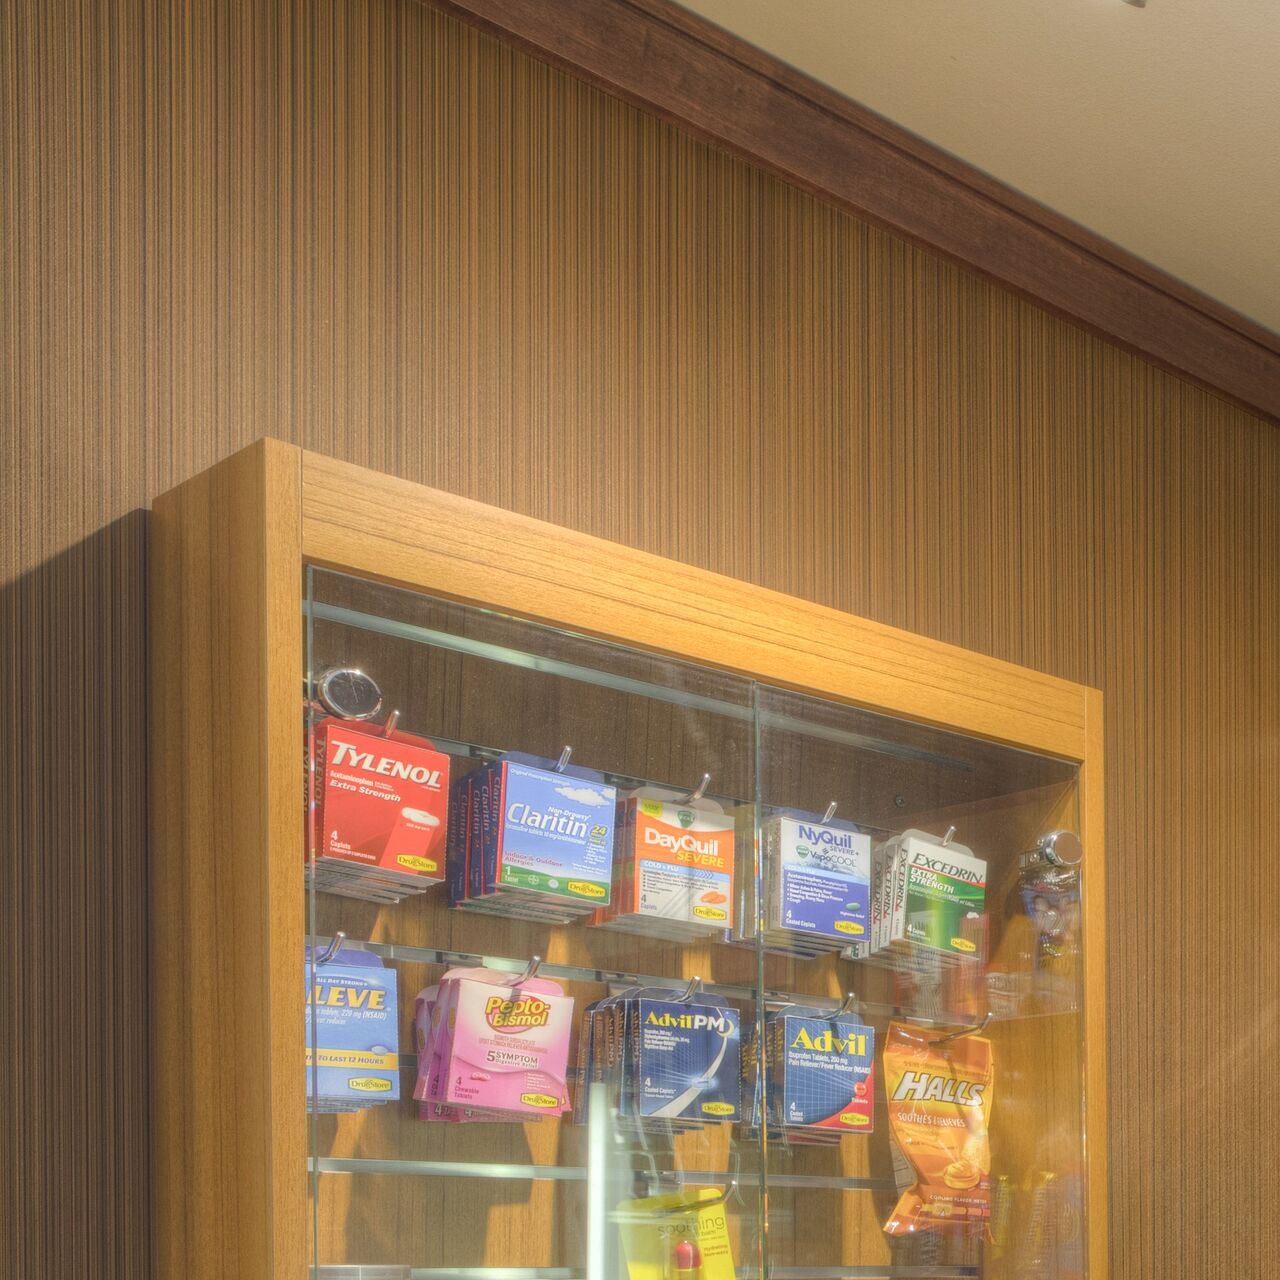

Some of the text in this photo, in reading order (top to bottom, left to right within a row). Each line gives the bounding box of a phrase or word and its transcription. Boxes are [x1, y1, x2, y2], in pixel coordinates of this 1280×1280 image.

[331, 740, 441, 788] TYLENOL
[330, 779, 357, 792] Extra
[359, 786, 401, 802] Strength
[507, 802, 588, 838] Claritin
[548, 805, 592, 820] Non-Drowsy
[330, 830, 338, 841] 4
[592, 825, 607, 836] 24
[799, 825, 852, 849] NyQuil
[644, 827, 719, 856] DayQuil
[676, 850, 725, 868] SEVERE
[809, 850, 856, 868] VapoCOOL
[913, 852, 984, 883] EXCEDRIN
[911, 868, 937, 880] EXTRA
[910, 875, 954, 894] STRENGTH
[486, 997, 550, 1015] Pepto-
[493, 1011, 548, 1027] Bismol
[644, 1011, 725, 1032] Advil PM
[789, 1027, 867, 1057] Advil
[486, 1050, 538, 1064] 5 SYMPTOM
[892, 1071, 985, 1107] HALLS
[658, 1216, 725, 1238] soothing
